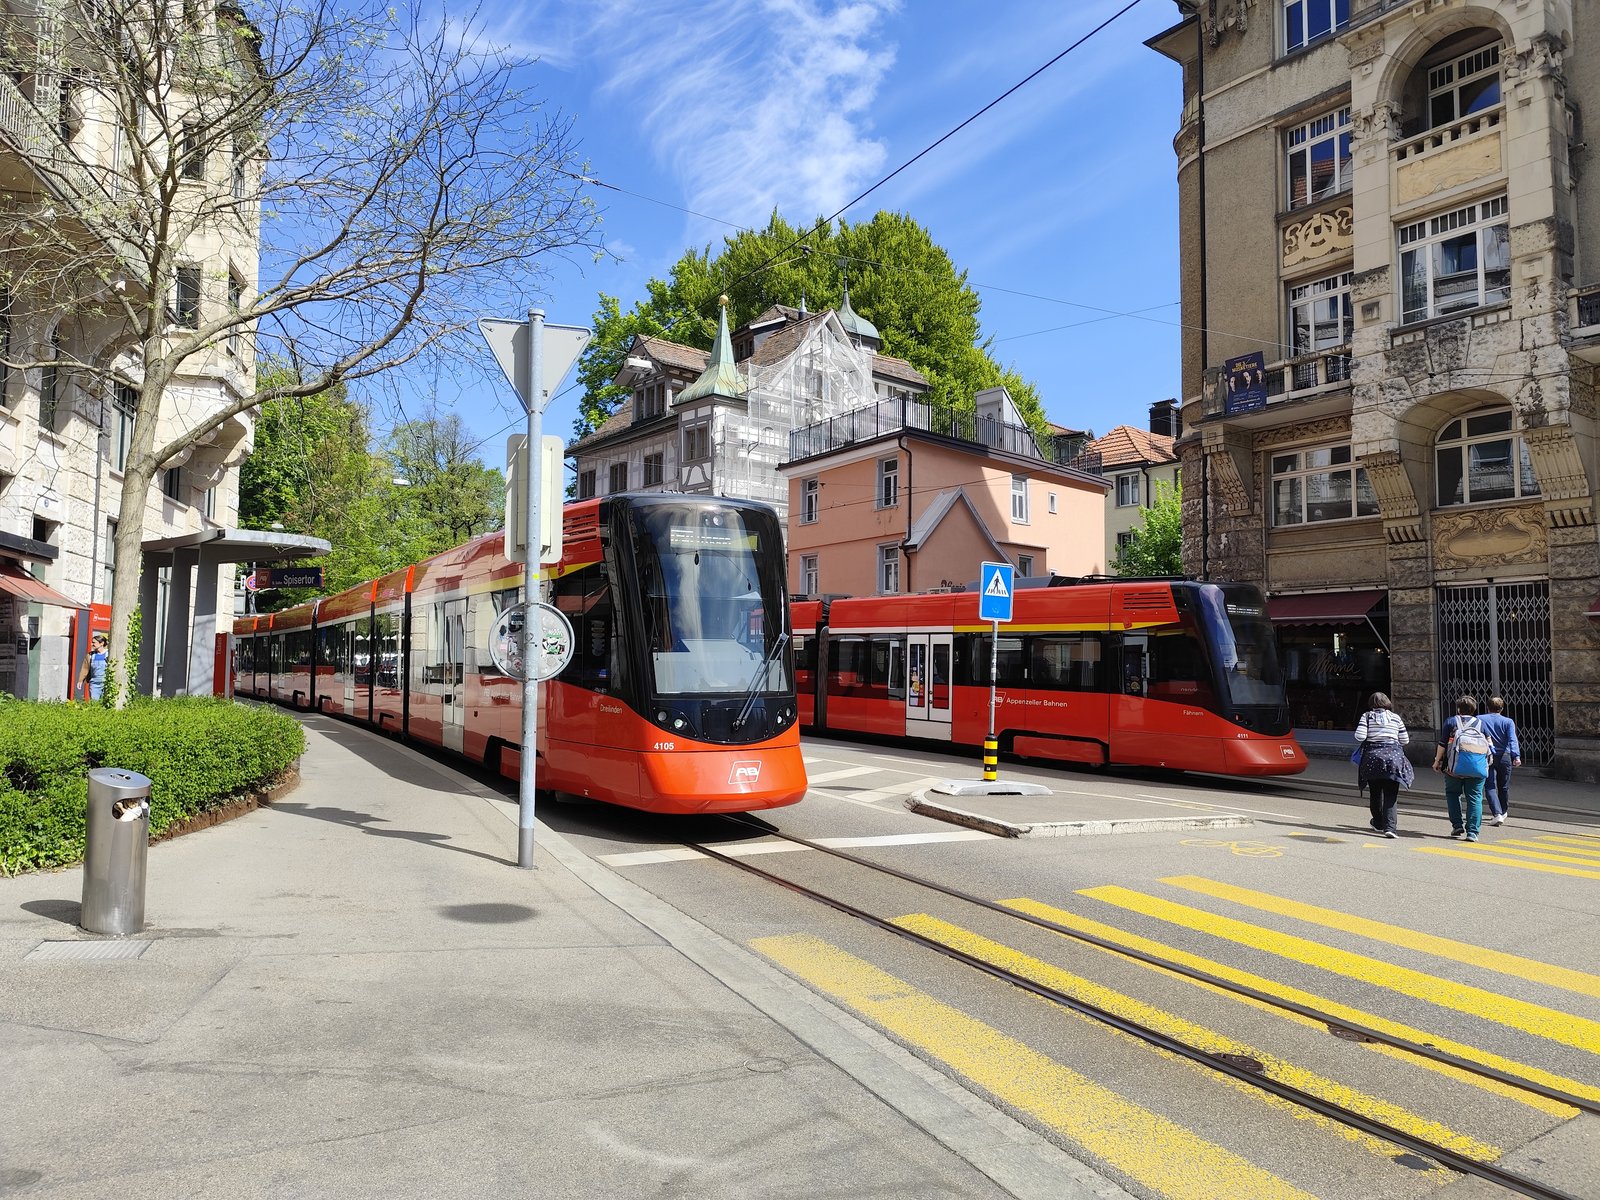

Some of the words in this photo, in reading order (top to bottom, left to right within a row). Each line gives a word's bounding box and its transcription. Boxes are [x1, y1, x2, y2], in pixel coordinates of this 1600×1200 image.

[283, 574, 315, 586] Spisertor
[1006, 697, 1042, 706] Appenzeller
[1043, 699, 1068, 707] Bahnen
[600, 703, 623, 714] Dreilinden
[654, 742, 675, 751] 4105
